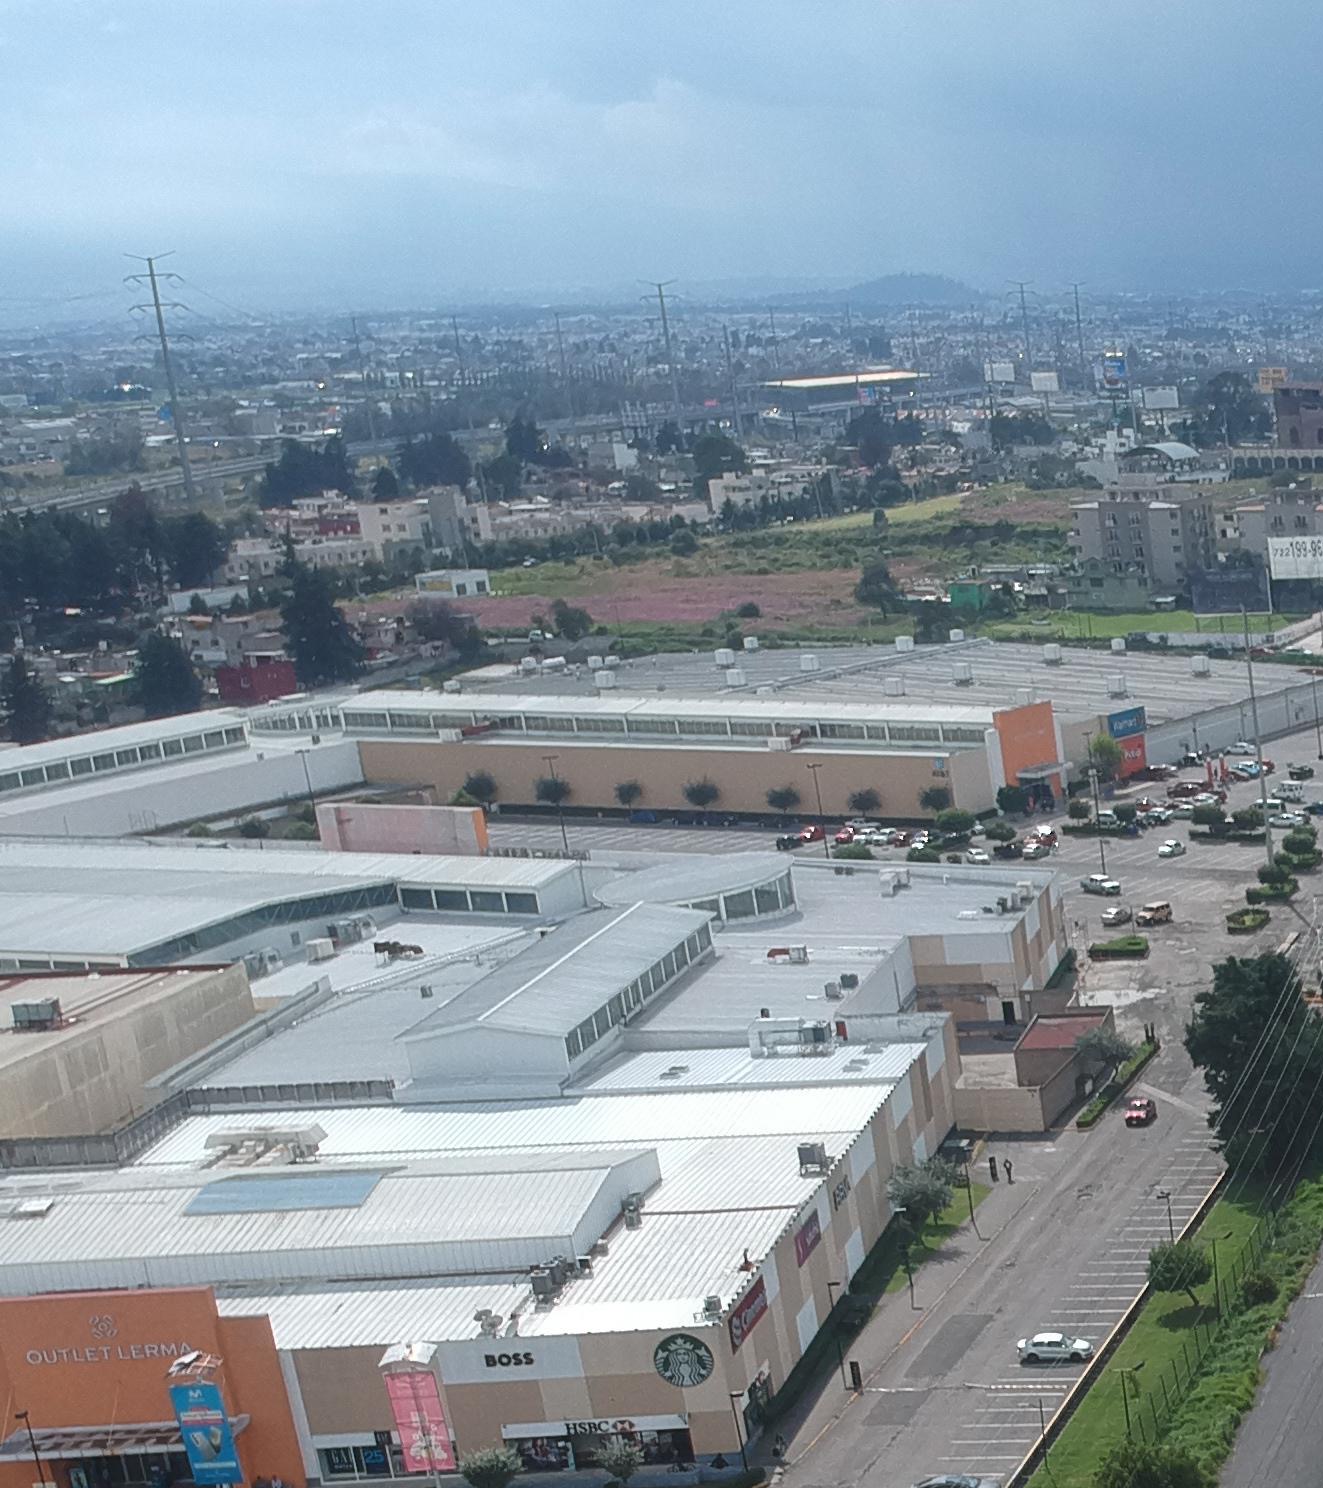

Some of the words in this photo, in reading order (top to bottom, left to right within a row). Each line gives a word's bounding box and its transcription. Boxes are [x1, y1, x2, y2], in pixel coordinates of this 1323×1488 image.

[26, 1346, 111, 1365] OUTLET
[117, 1342, 193, 1361] LERMA
[484, 1352, 535, 1367] BOSS
[564, 1421, 610, 1435] HSBC
